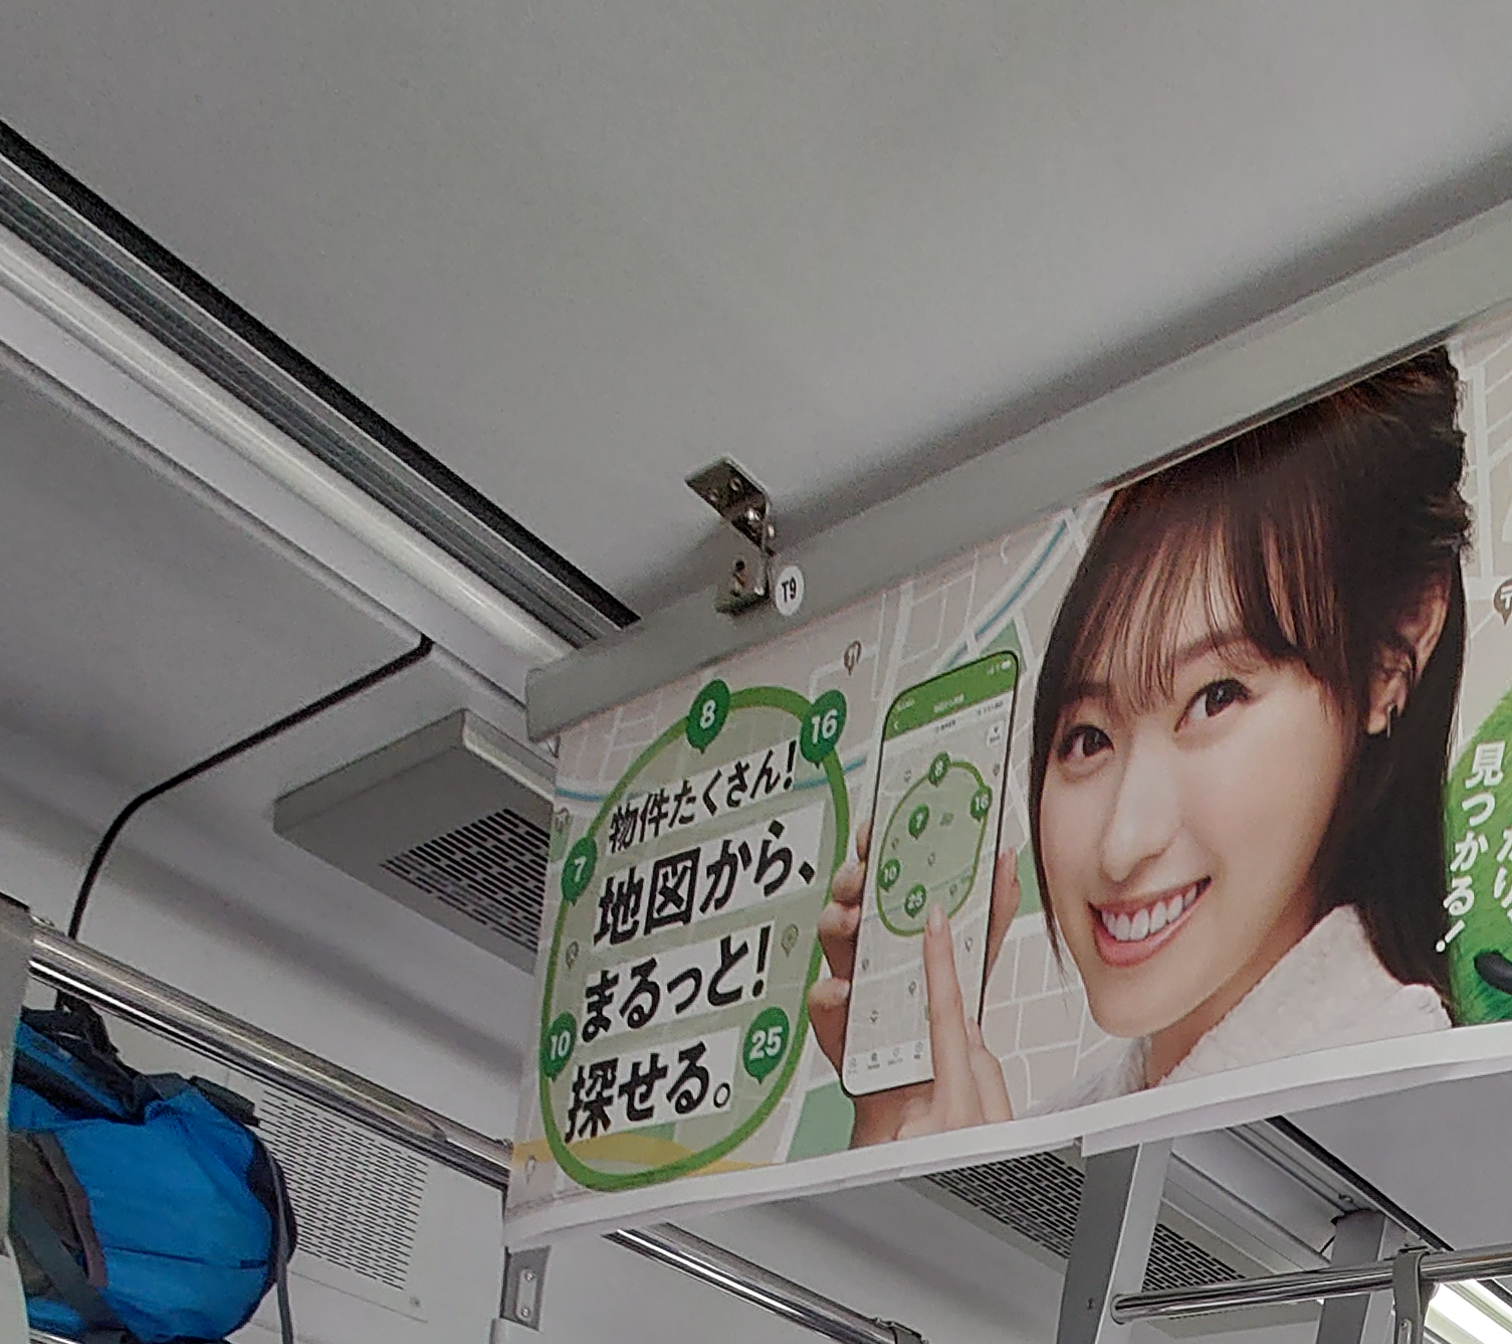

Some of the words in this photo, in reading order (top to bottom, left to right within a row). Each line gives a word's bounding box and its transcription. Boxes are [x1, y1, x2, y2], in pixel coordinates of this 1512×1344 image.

[781, 576, 797, 604] T9
[699, 700, 717, 730] 8
[810, 714, 838, 745] 16
[608, 739, 798, 855] 物件たくさん!
[974, 793, 989, 811] 16
[1435, 740, 1506, 953] 見つかる!
[571, 855, 587, 882] 7
[592, 820, 816, 947] 地図から、
[883, 864, 897, 883] 10
[581, 926, 771, 1043] まるっと!
[548, 1030, 571, 1059] 10
[750, 1027, 784, 1059] 25
[564, 1040, 732, 1144] 探せる。
